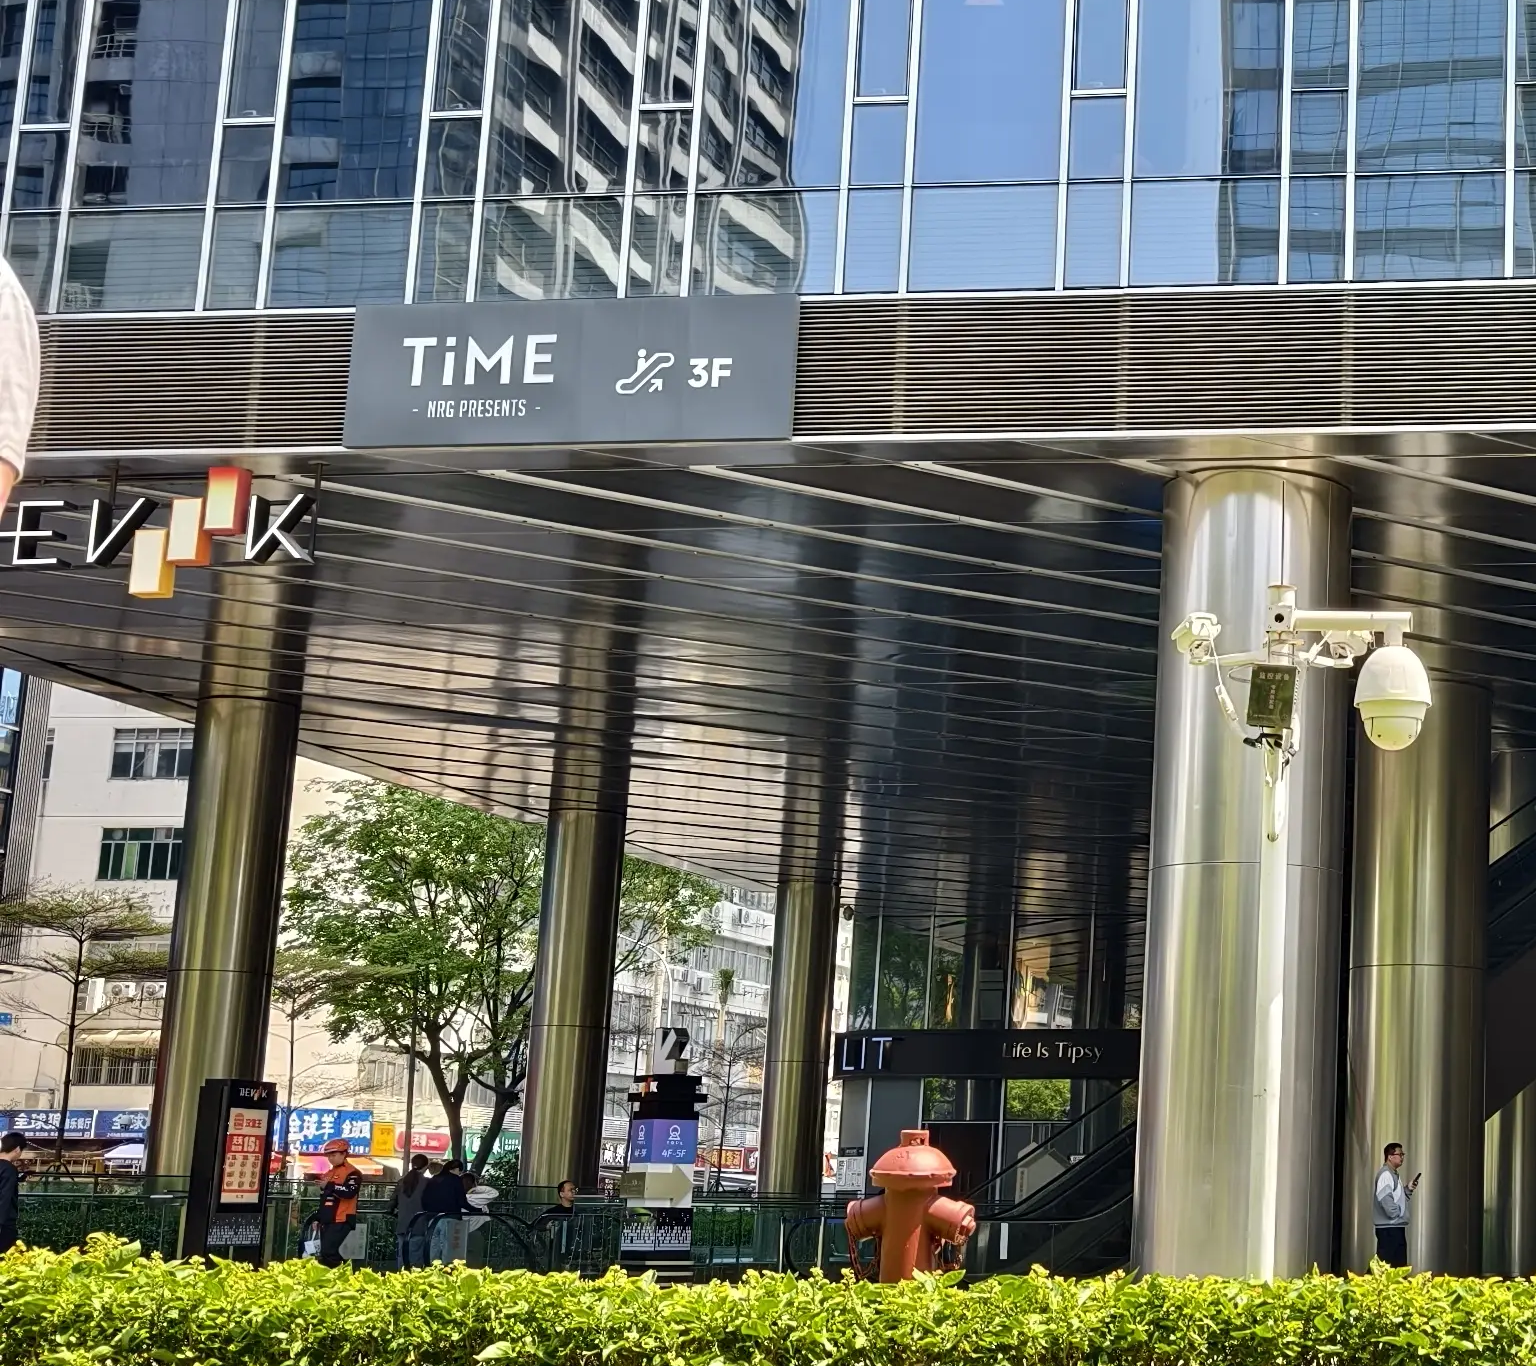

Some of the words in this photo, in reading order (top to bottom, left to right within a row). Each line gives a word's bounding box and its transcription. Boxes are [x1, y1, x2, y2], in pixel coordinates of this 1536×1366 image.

[687, 357, 733, 389] 3F
[427, 400, 455, 418] NRG
[459, 399, 527, 418] PRESENTS
[842, 1037, 893, 1071] LIT
[1002, 1042, 1032, 1058] Life
[1036, 1041, 1049, 1058] Is
[1055, 1041, 1104, 1063] Tipsy
